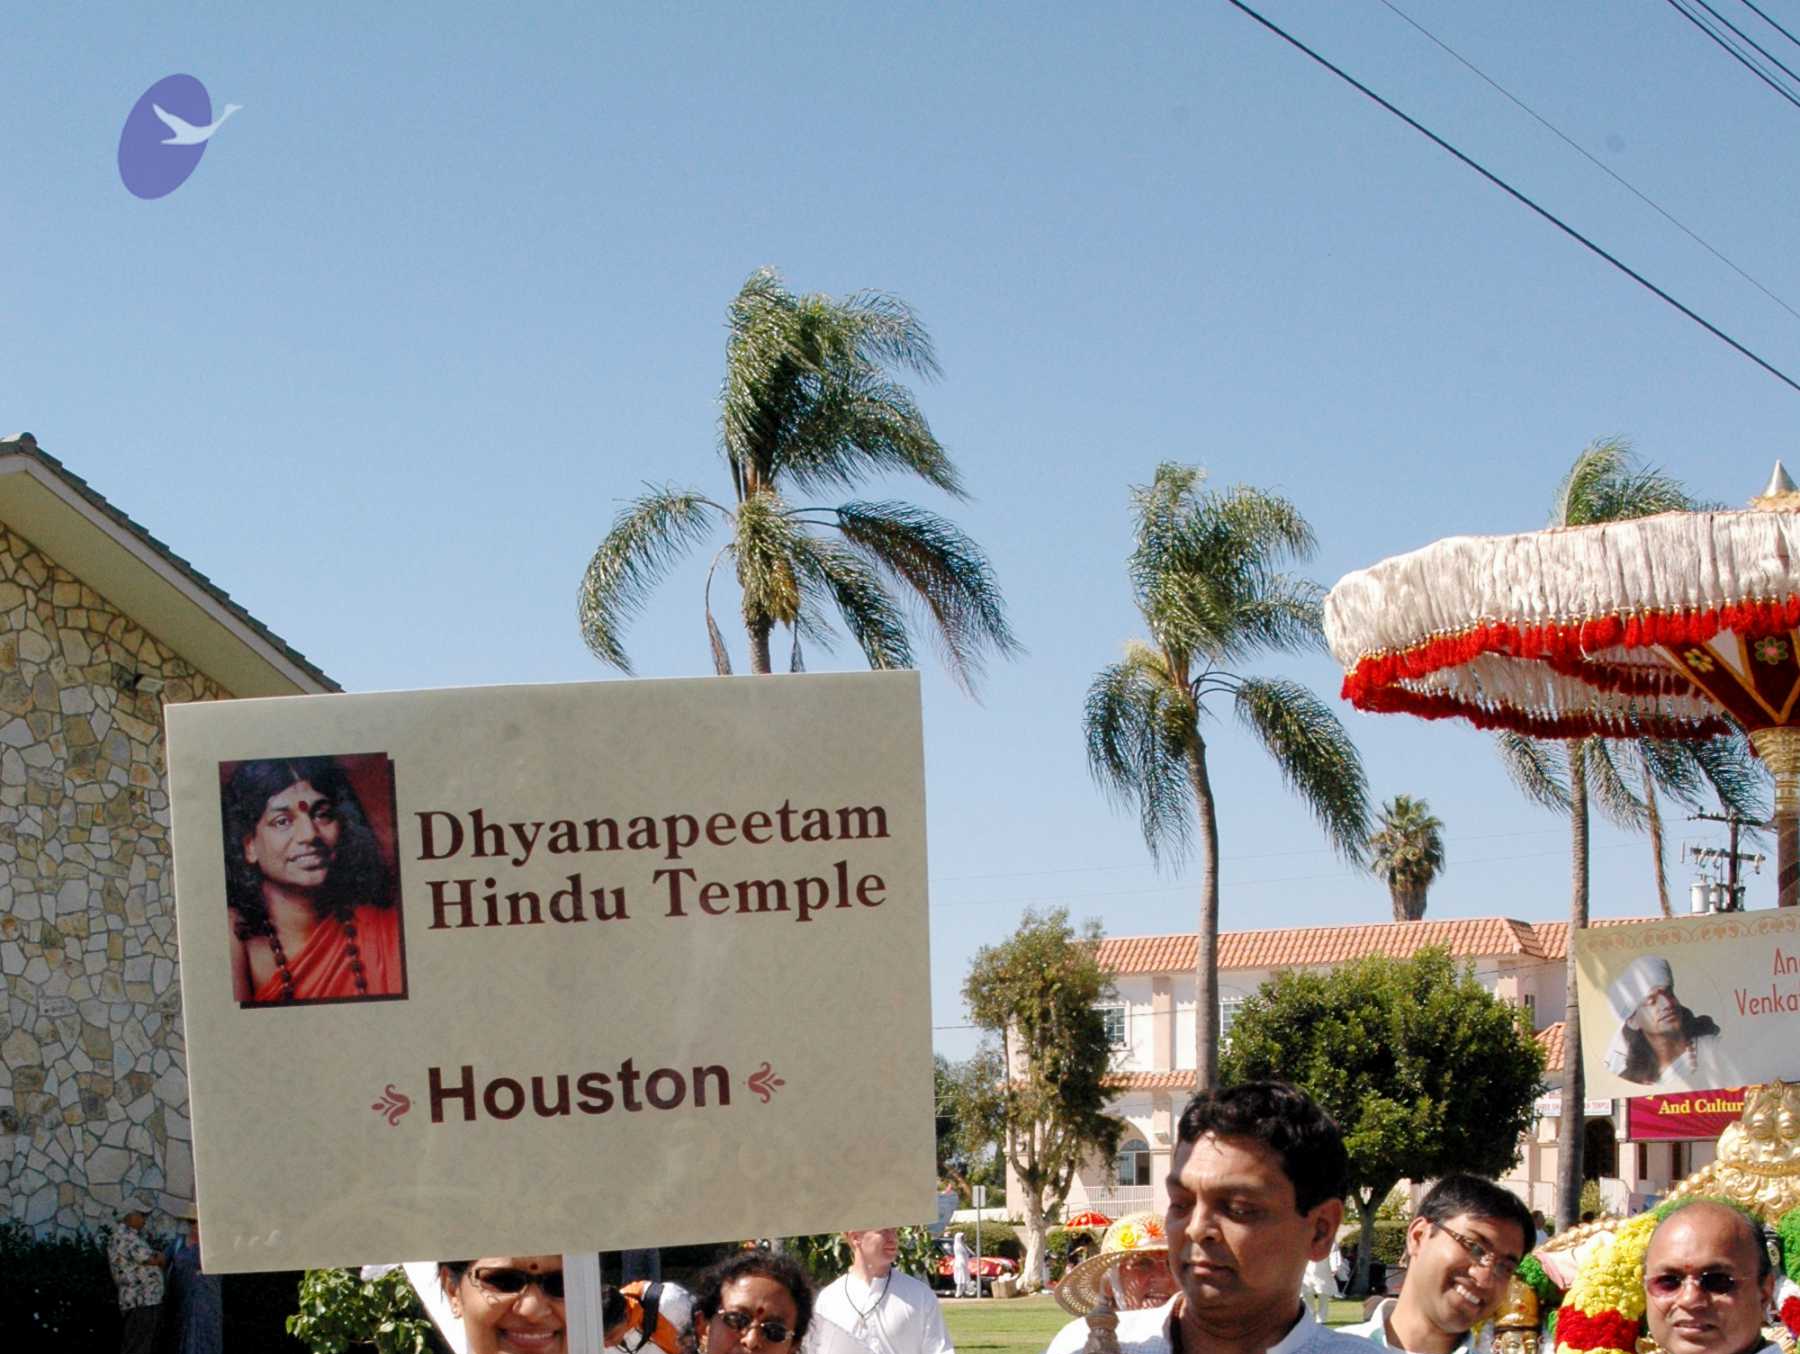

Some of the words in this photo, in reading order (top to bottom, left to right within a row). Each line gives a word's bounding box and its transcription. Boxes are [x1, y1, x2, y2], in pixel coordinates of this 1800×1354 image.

[414, 799, 890, 867] Dhyanapeetam
[425, 873, 631, 930] Hindu
[653, 860, 888, 922] Temple
[1773, 947, 1800, 976] An
[1734, 983, 1800, 1016] Venka
[427, 1057, 732, 1124] Houston
[1658, 1099, 1691, 1115] And
[1694, 1098, 1745, 1113] Cultur
